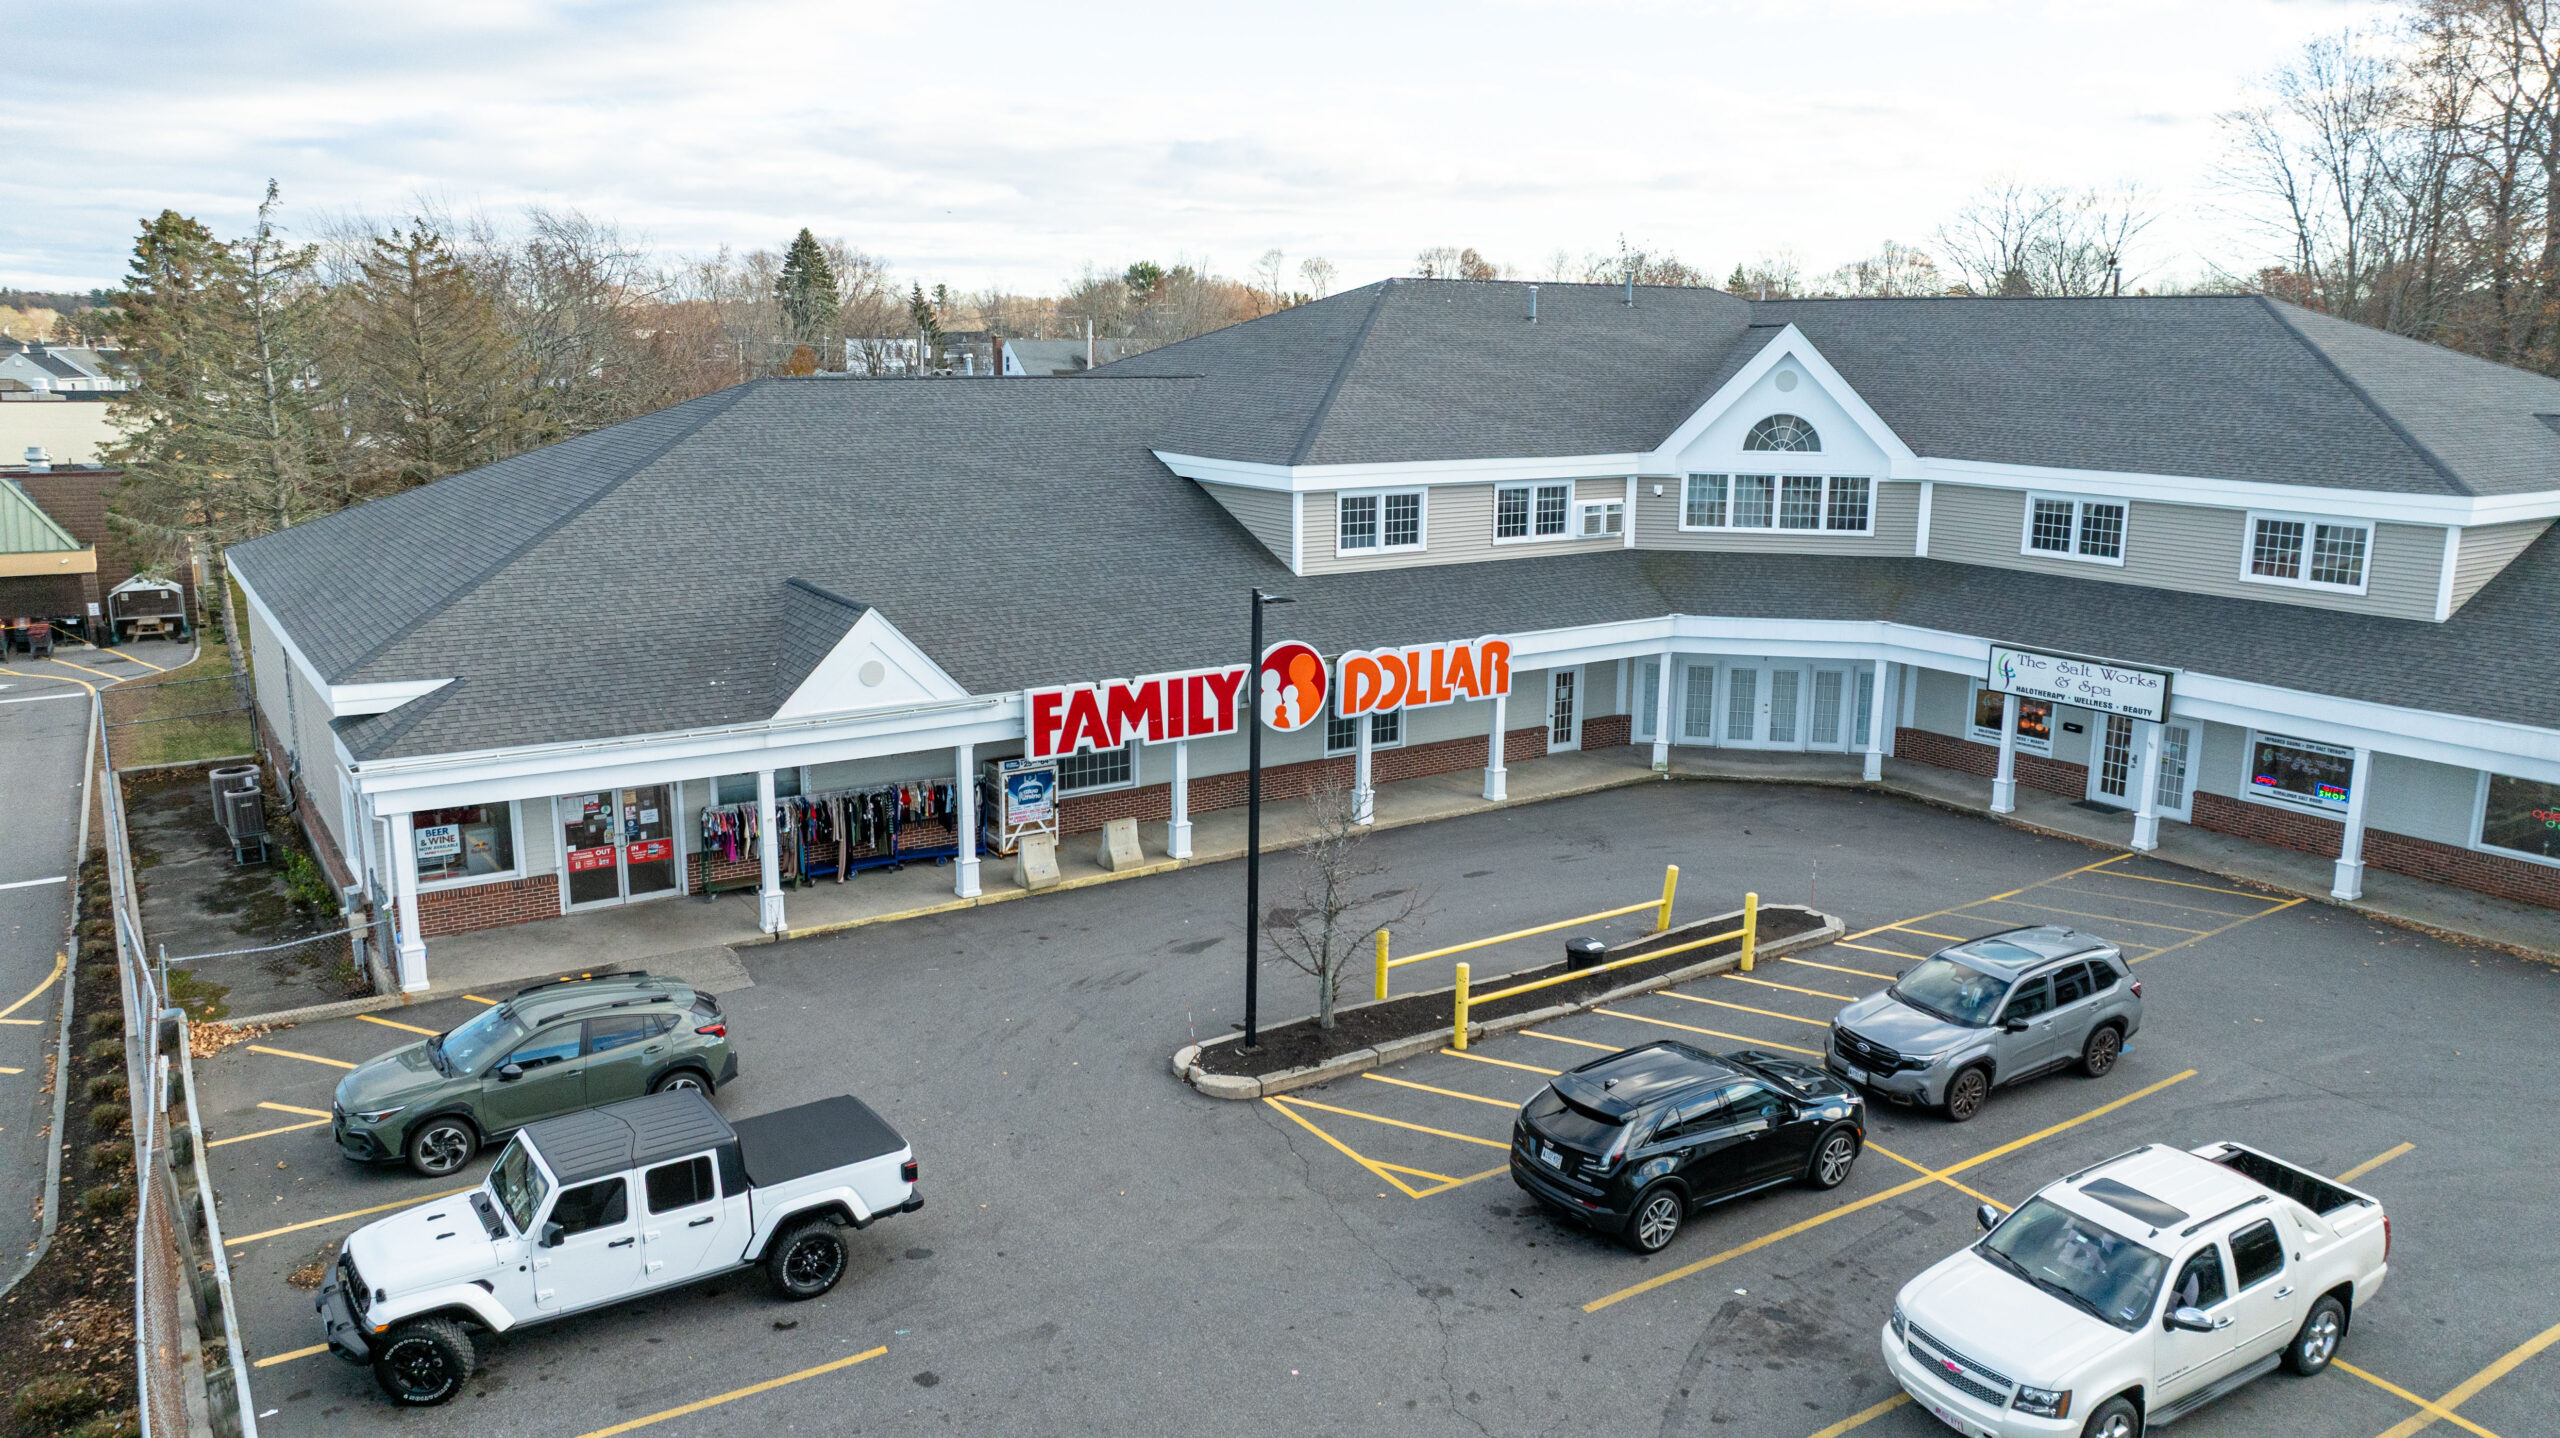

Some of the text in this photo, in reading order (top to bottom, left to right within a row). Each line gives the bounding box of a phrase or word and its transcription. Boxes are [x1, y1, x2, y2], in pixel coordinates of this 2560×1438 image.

[2017, 654, 2158, 688] The Salt Works
[2054, 676, 2112, 697] & Spa
[1033, 640, 1510, 757] FAMILY DOLLAR
[2015, 685, 2066, 701] HALOTHERAPY
[2073, 696, 2114, 710] WELLNESS
[2122, 705, 2153, 716] BEAUTY
[2256, 776, 2277, 785] OPEN
[2322, 785, 2345, 794] GIFT
[2318, 790, 2346, 801] SHOP
[425, 827, 449, 838] BEER
[428, 834, 456, 846] WINE
[595, 848, 611, 856] OUT
